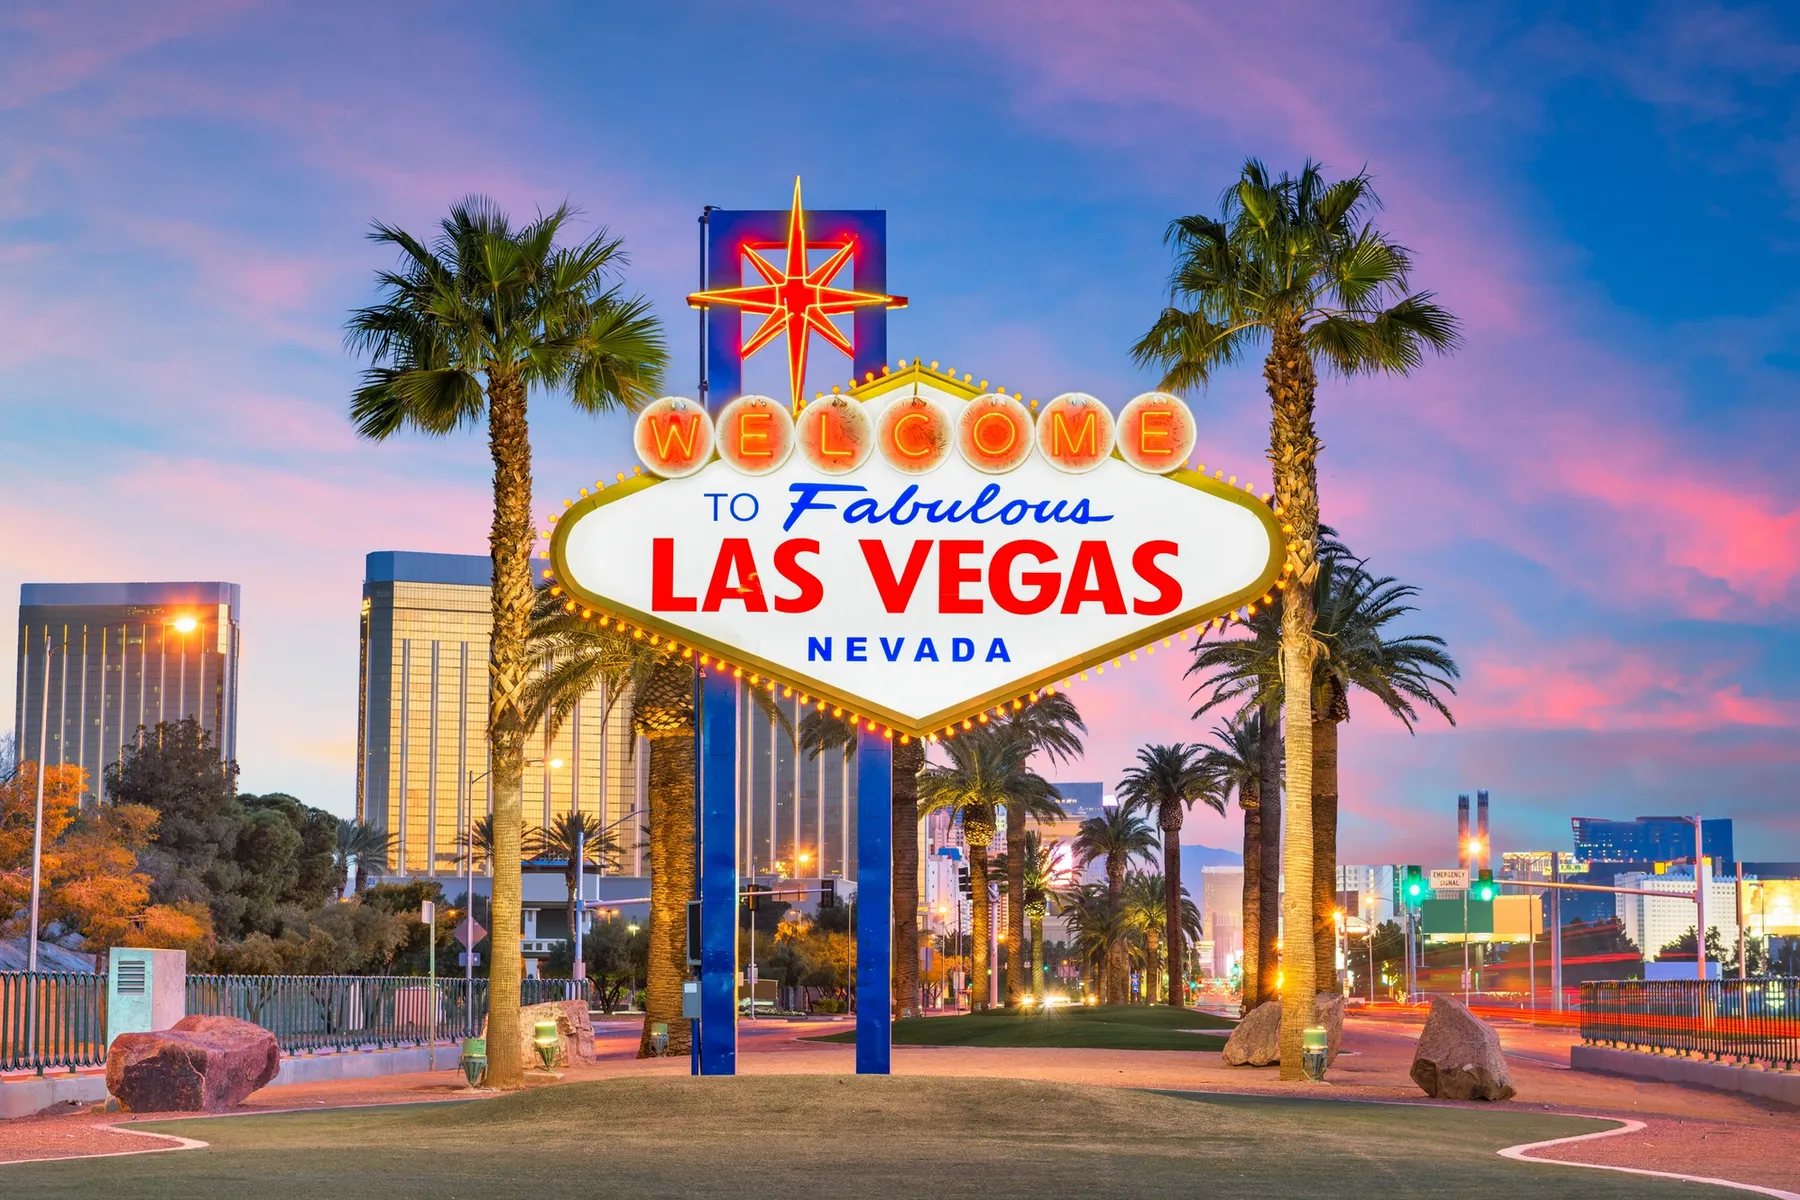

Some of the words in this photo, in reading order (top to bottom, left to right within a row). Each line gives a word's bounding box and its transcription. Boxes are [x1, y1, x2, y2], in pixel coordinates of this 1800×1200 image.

[648, 409, 1175, 462] WELCOME
[704, 493, 760, 522] TO
[783, 483, 1114, 533] Fabulous
[651, 537, 825, 614] LAS
[858, 539, 1183, 617] VEGAS
[807, 636, 1012, 663] NEVADA
